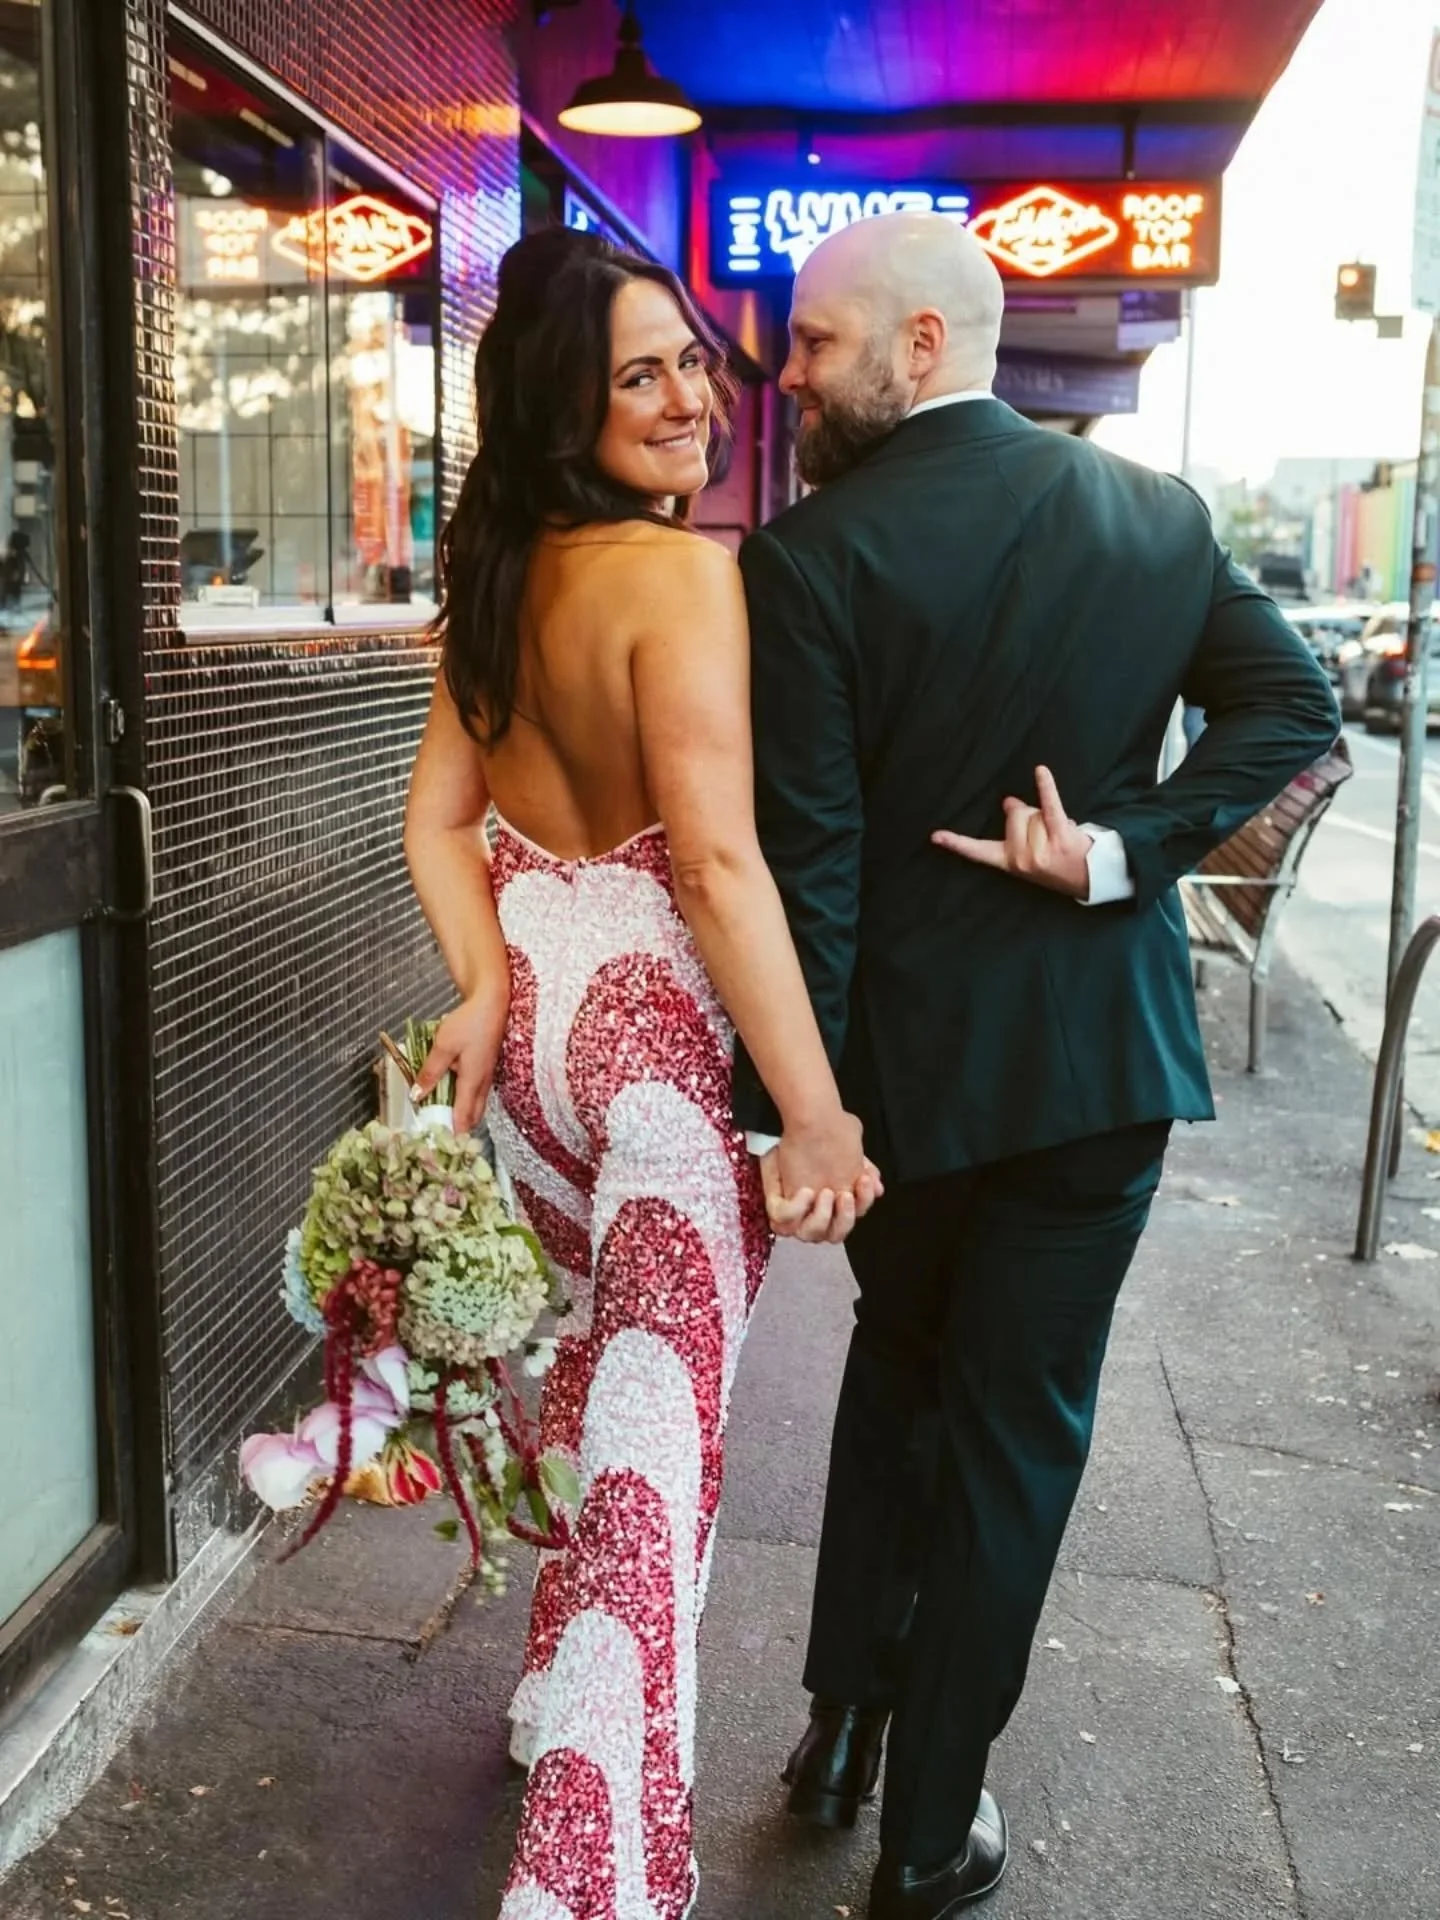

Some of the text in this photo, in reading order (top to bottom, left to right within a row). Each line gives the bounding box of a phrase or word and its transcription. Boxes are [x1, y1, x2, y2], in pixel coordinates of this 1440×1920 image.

[1123, 193, 1204, 220] ROOF
[1132, 219, 1193, 244] TOP
[1131, 243, 1191, 269] BAR
